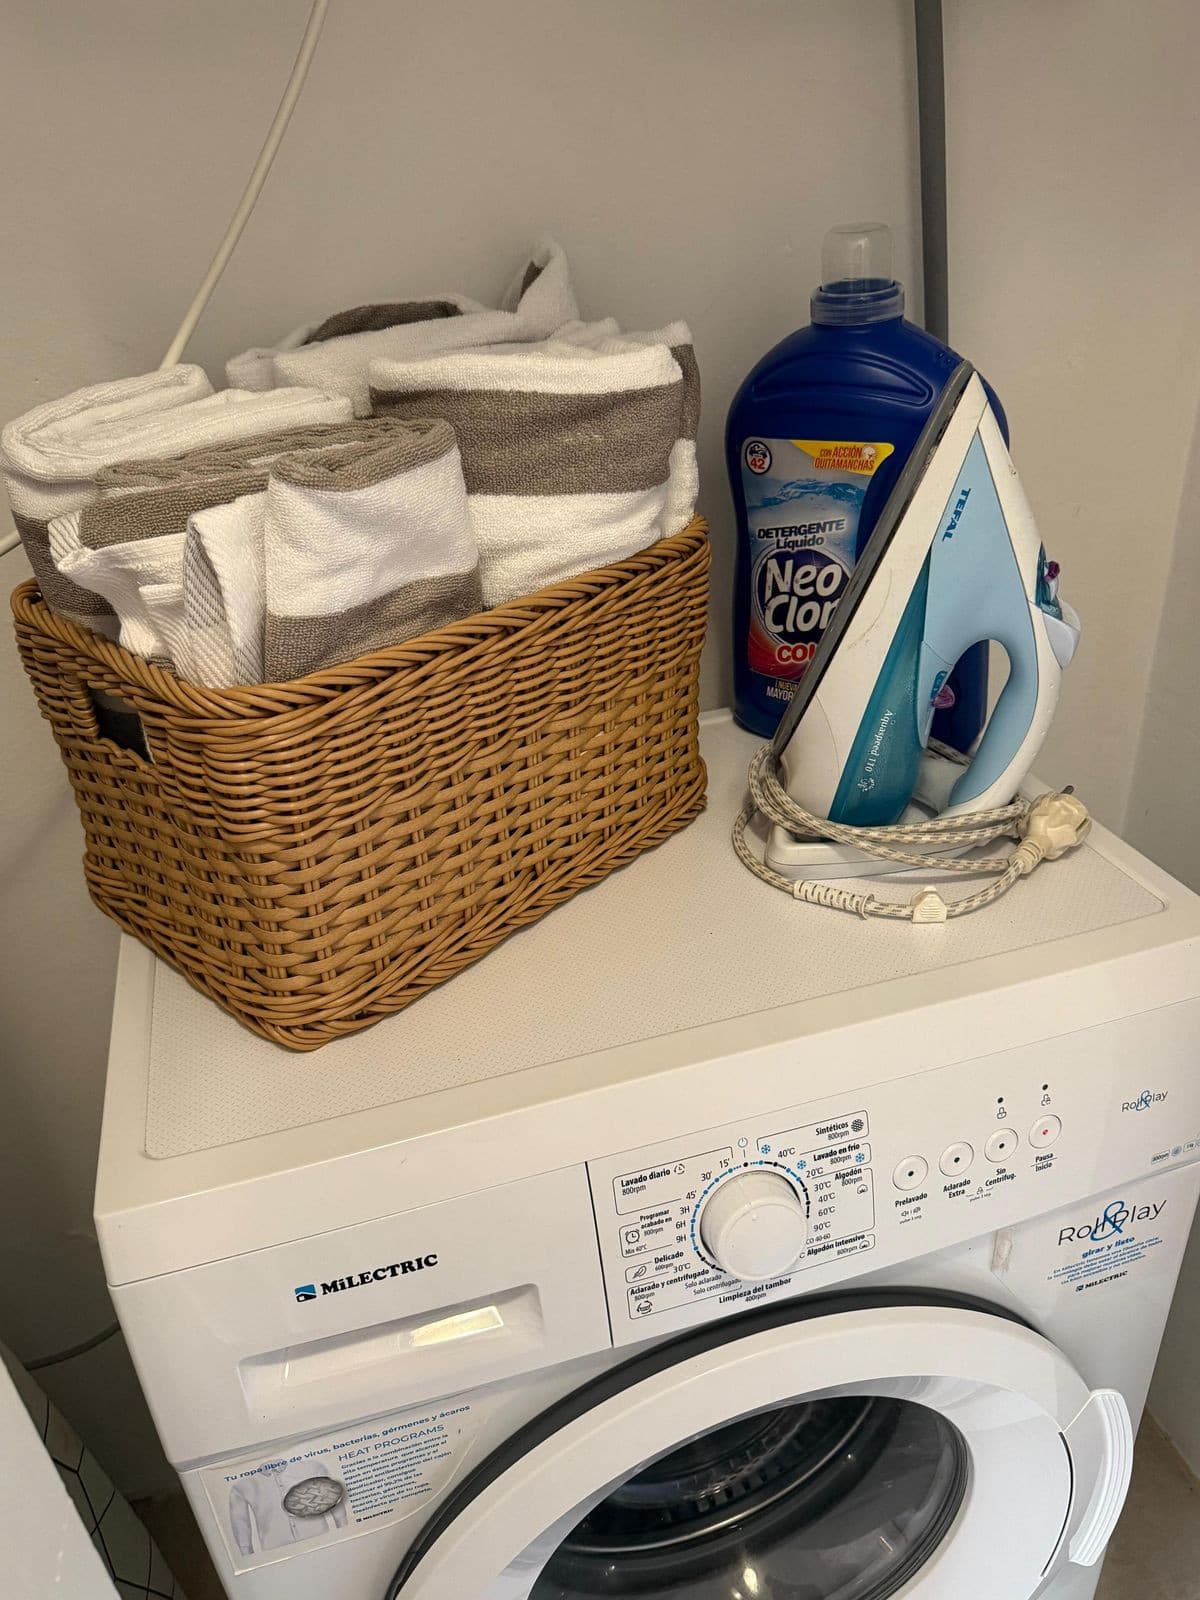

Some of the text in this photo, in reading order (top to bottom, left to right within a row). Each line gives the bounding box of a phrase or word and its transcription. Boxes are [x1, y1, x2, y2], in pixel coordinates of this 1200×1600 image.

[832, 445, 863, 459] ACCIÓN
[751, 457, 766, 470] 42
[815, 457, 875, 472] QUITAMANCHAS
[942, 488, 971, 542] TEFAL
[758, 518, 846, 539] DETERGENTE
[776, 534, 825, 551] Líquido
[765, 558, 843, 601] Neo
[766, 686, 795, 702] MAYOR
[864, 709, 893, 773] Aquaspeed 110
[815, 1121, 849, 1136] Sintéticos
[813, 1142, 861, 1162] Lavado en frío
[1034, 1152, 1055, 1163] Pausa
[834, 1166, 862, 1181] Algodón
[995, 1167, 1007, 1176] Sin
[1034, 1161, 1054, 1172] Inicio
[620, 1168, 671, 1188] Lavado diario
[942, 1178, 972, 1193] Aclarado
[985, 1173, 1017, 1187] Centrifug.
[621, 1184, 647, 1196] 800rpm
[948, 1188, 966, 1199] Extra
[894, 1191, 929, 1208] Prelavado
[639, 1209, 670, 1223] Programar
[679, 1205, 690, 1215] 3H
[675, 1219, 687, 1230] 6H
[675, 1233, 687, 1244] 9H
[806, 1242, 834, 1257] Algodón
[834, 1233, 866, 1248] Intensivo
[1081, 1246, 1105, 1260] girar
[1105, 1243, 1114, 1251] y
[1114, 1236, 1136, 1248] listo
[653, 1250, 684, 1265] Delicado
[629, 1268, 710, 1296] Aclarado y centrifugado
[684, 1280, 698, 1289] Solo
[692, 1287, 705, 1296] Solo
[718, 1276, 792, 1304] Limpieza del tambor
[224, 1403, 471, 1483] Tu ropa libre de virus, bacterias, gérmenes y ácaros
[337, 1423, 446, 1463] HEAT PROGRAMS
